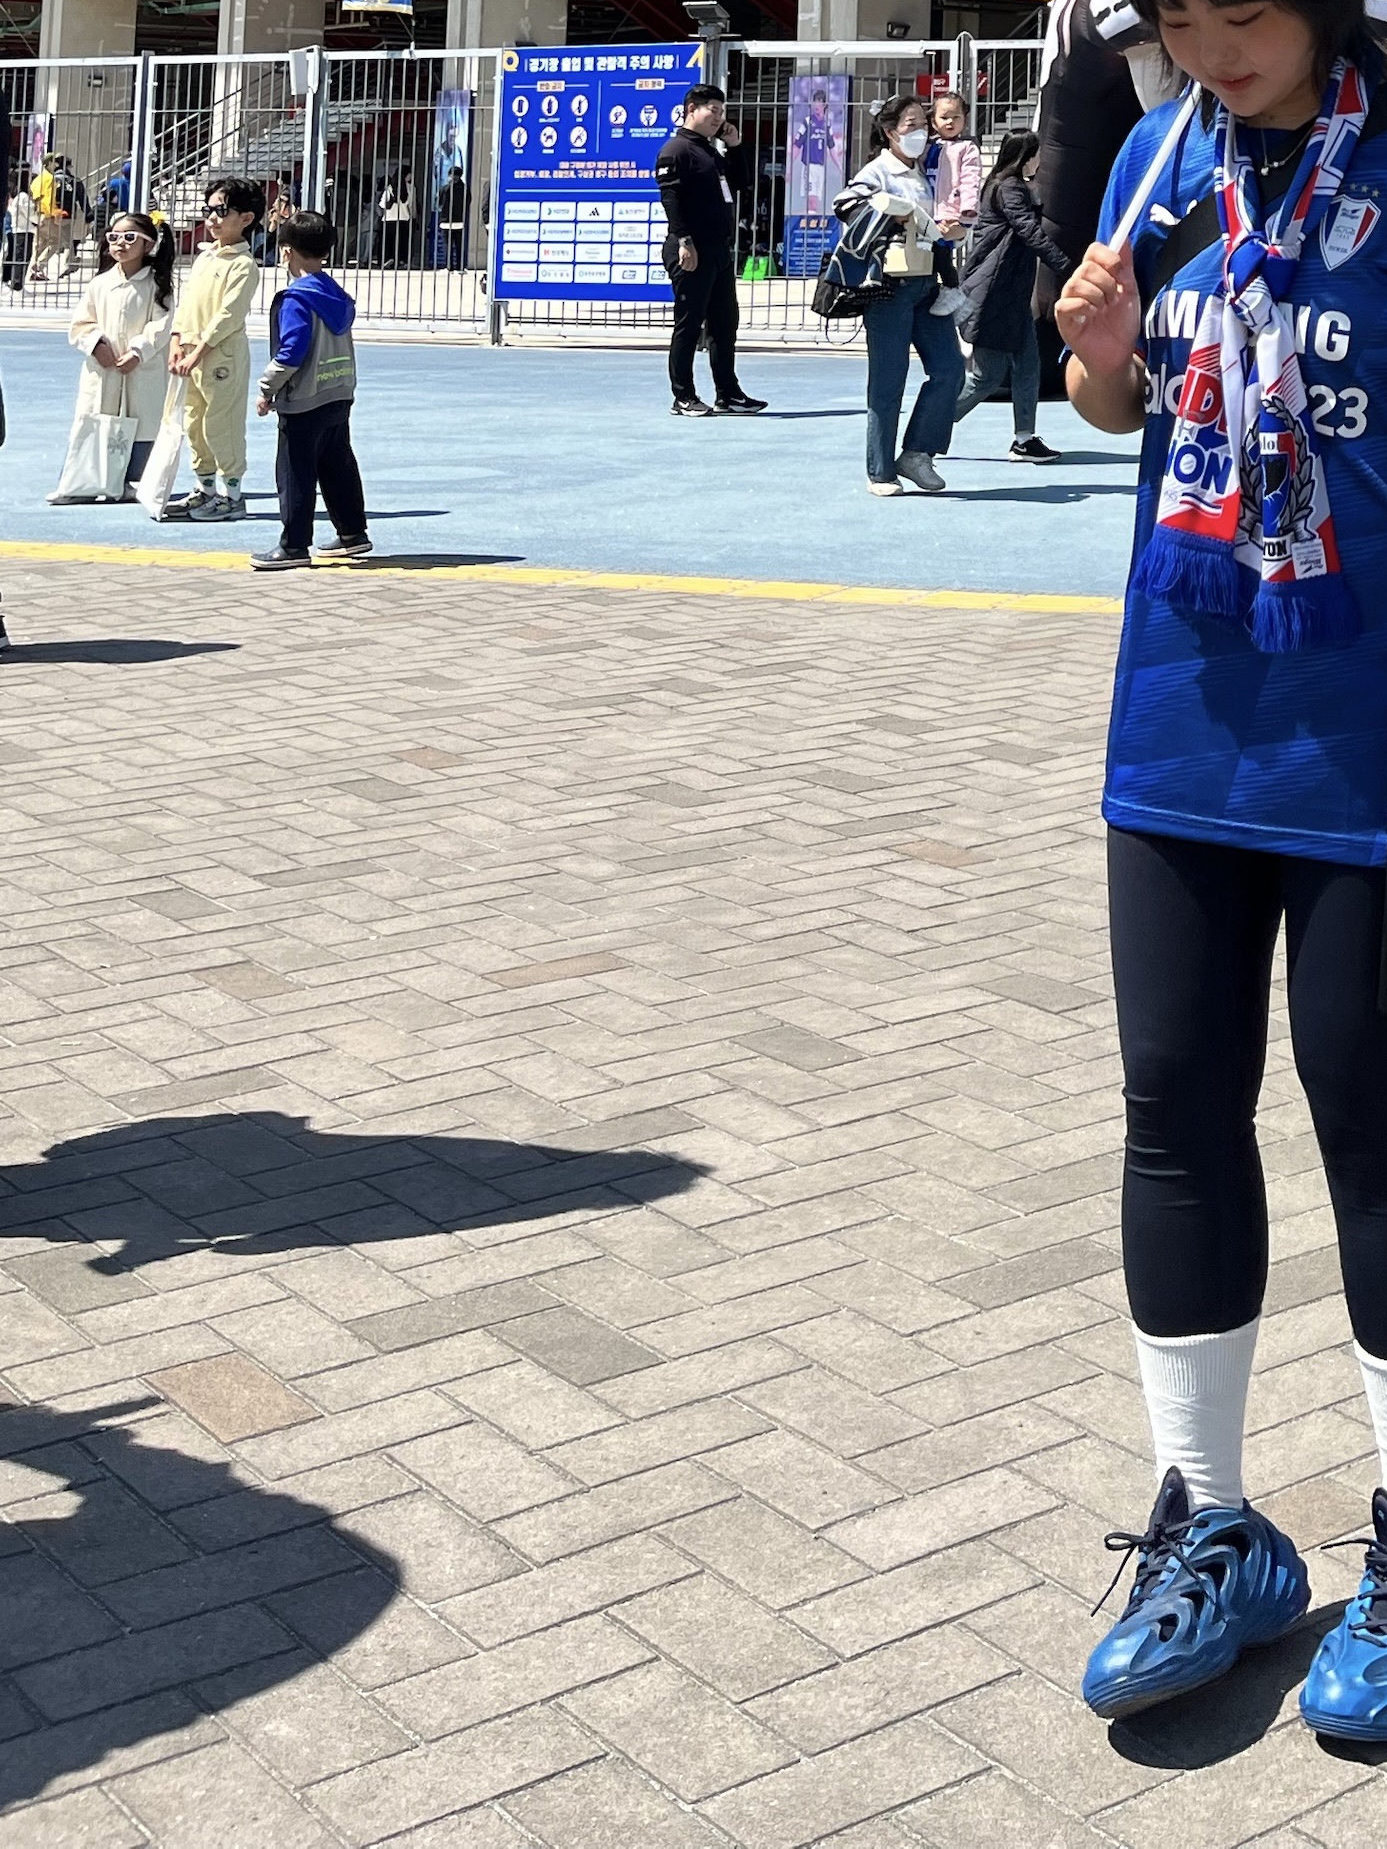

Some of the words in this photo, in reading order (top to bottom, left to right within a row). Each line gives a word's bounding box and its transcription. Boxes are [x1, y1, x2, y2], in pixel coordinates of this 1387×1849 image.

[529, 57, 559, 72] 경기장
[561, 56, 581, 72] 출입
[584, 56, 594, 71] 및
[597, 55, 627, 71] 관람객
[630, 54, 650, 70] 주의
[653, 54, 675, 70] 사항
